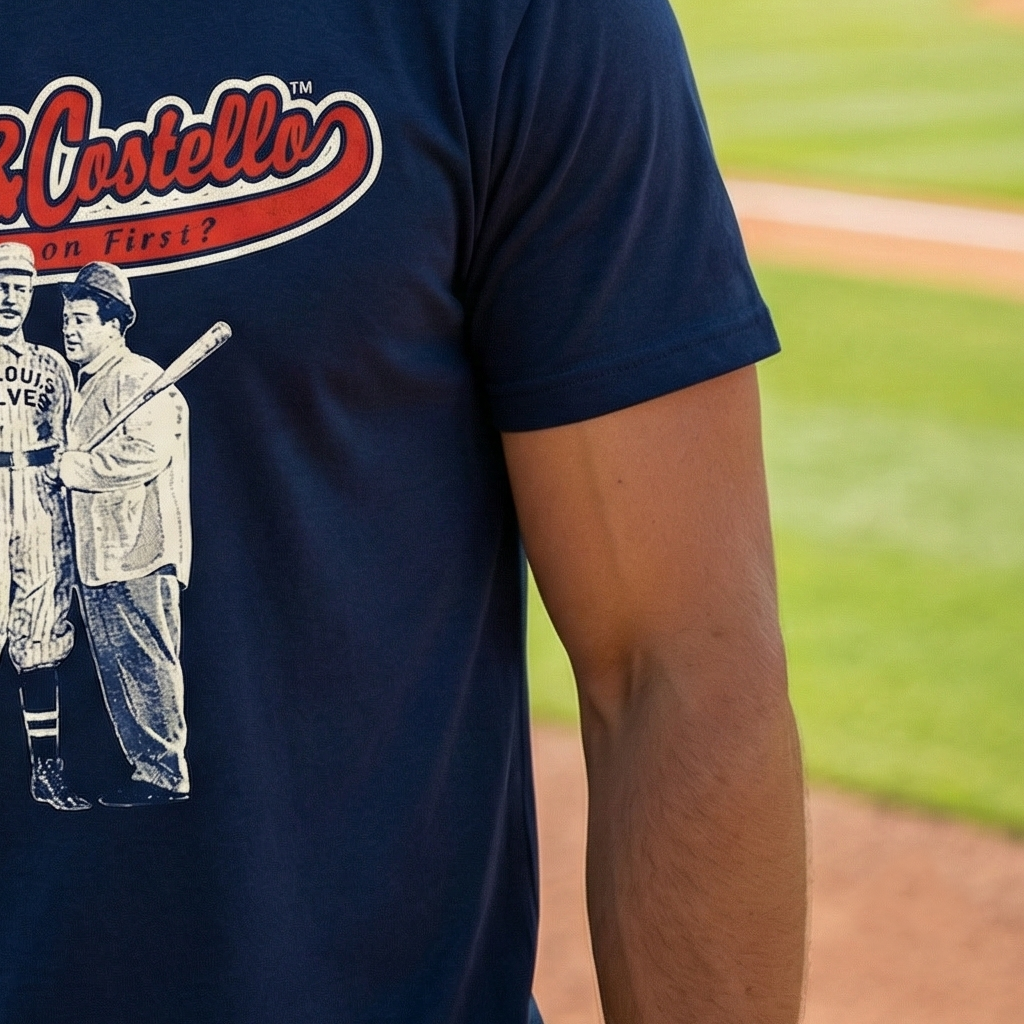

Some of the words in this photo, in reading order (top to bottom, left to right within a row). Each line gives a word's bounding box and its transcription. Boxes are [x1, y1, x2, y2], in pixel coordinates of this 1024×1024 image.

[289, 80, 313, 95] TM
[41, 237, 82, 261] on
[104, 216, 217, 256] First?
